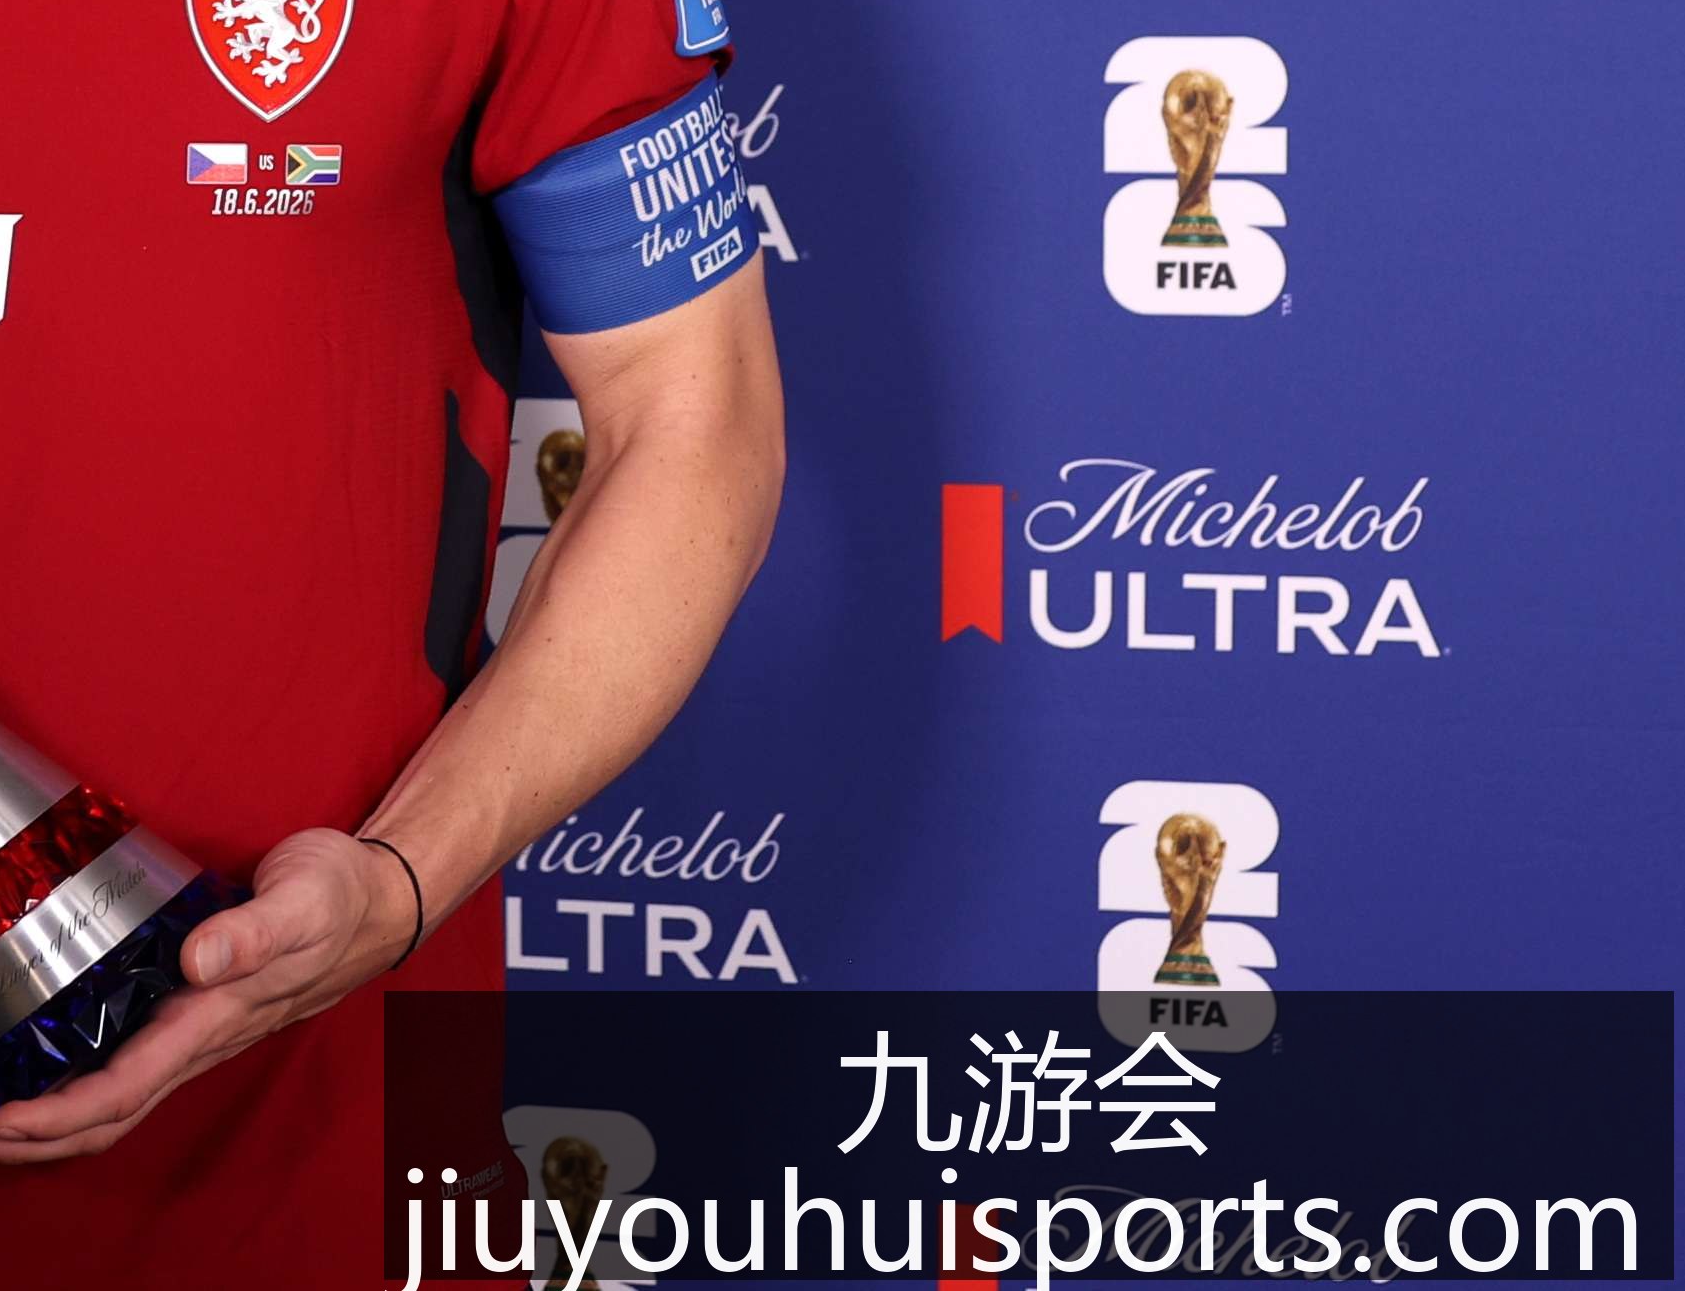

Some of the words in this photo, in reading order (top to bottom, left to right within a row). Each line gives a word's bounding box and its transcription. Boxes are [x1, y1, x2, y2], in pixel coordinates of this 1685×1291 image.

[630, 119, 736, 223] UNITES
[212, 188, 315, 215] 18.6.2026
[632, 223, 692, 267] the
[696, 240, 740, 276] FIFA
[1157, 262, 1237, 289] FIFA
[1024, 458, 1429, 553] Michelob
[1030, 569, 1440, 657] ULTRA
[516, 808, 785, 883] ichelob
[505, 896, 799, 984] LTRA
[1149, 998, 1228, 1027] FIFA
